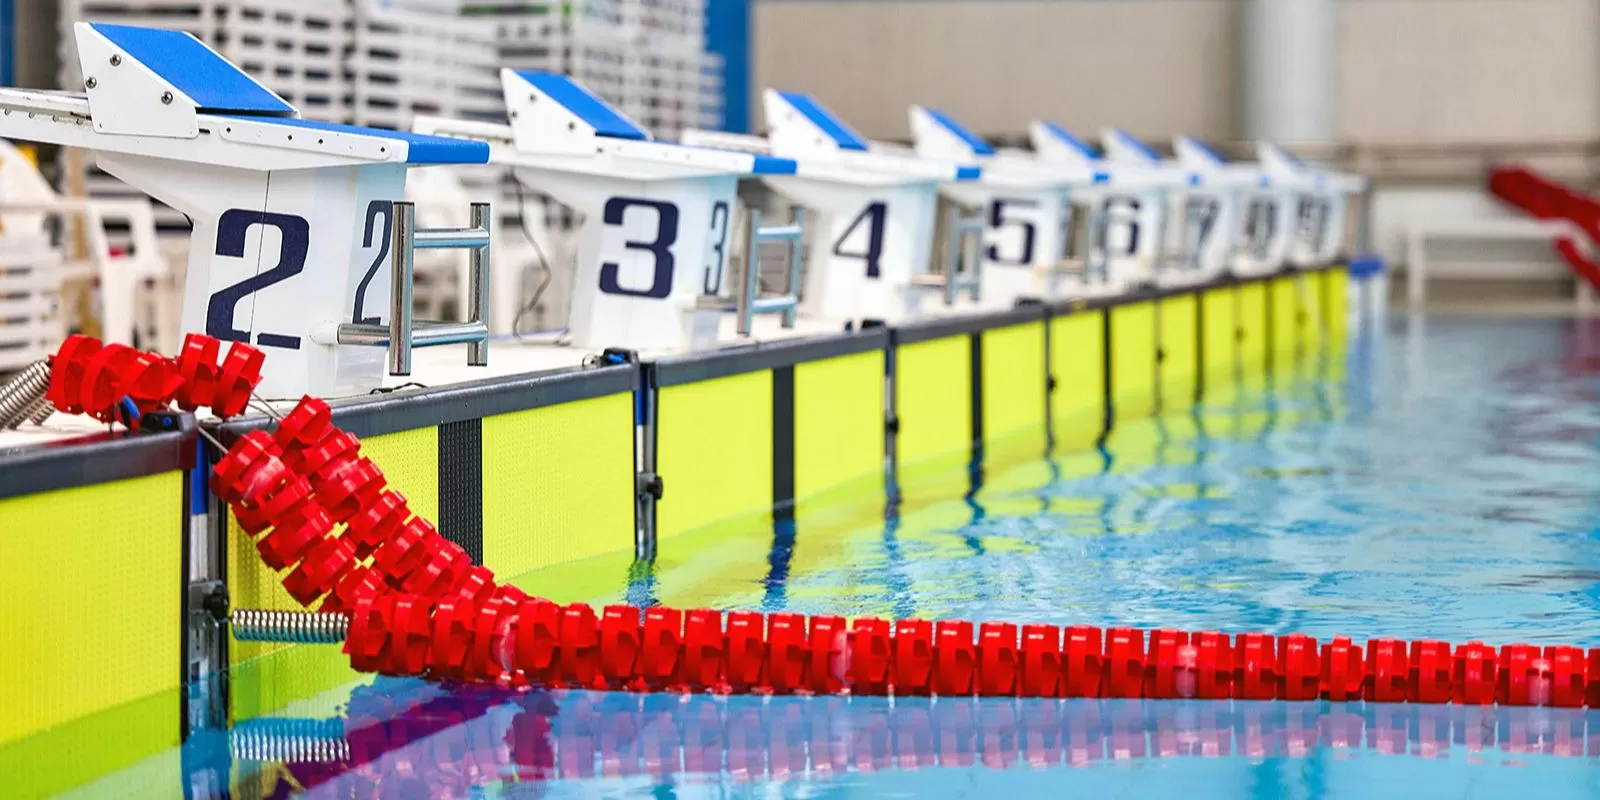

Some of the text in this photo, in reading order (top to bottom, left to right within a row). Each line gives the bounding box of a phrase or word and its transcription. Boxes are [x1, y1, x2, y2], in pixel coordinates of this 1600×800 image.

[352, 200, 393, 326] 2
[599, 196, 679, 299] 3
[704, 201, 728, 295] 3
[832, 201, 887, 279] 4
[986, 197, 1038, 265] 5
[1096, 195, 1140, 257] 6
[206, 208, 309, 350] 2
